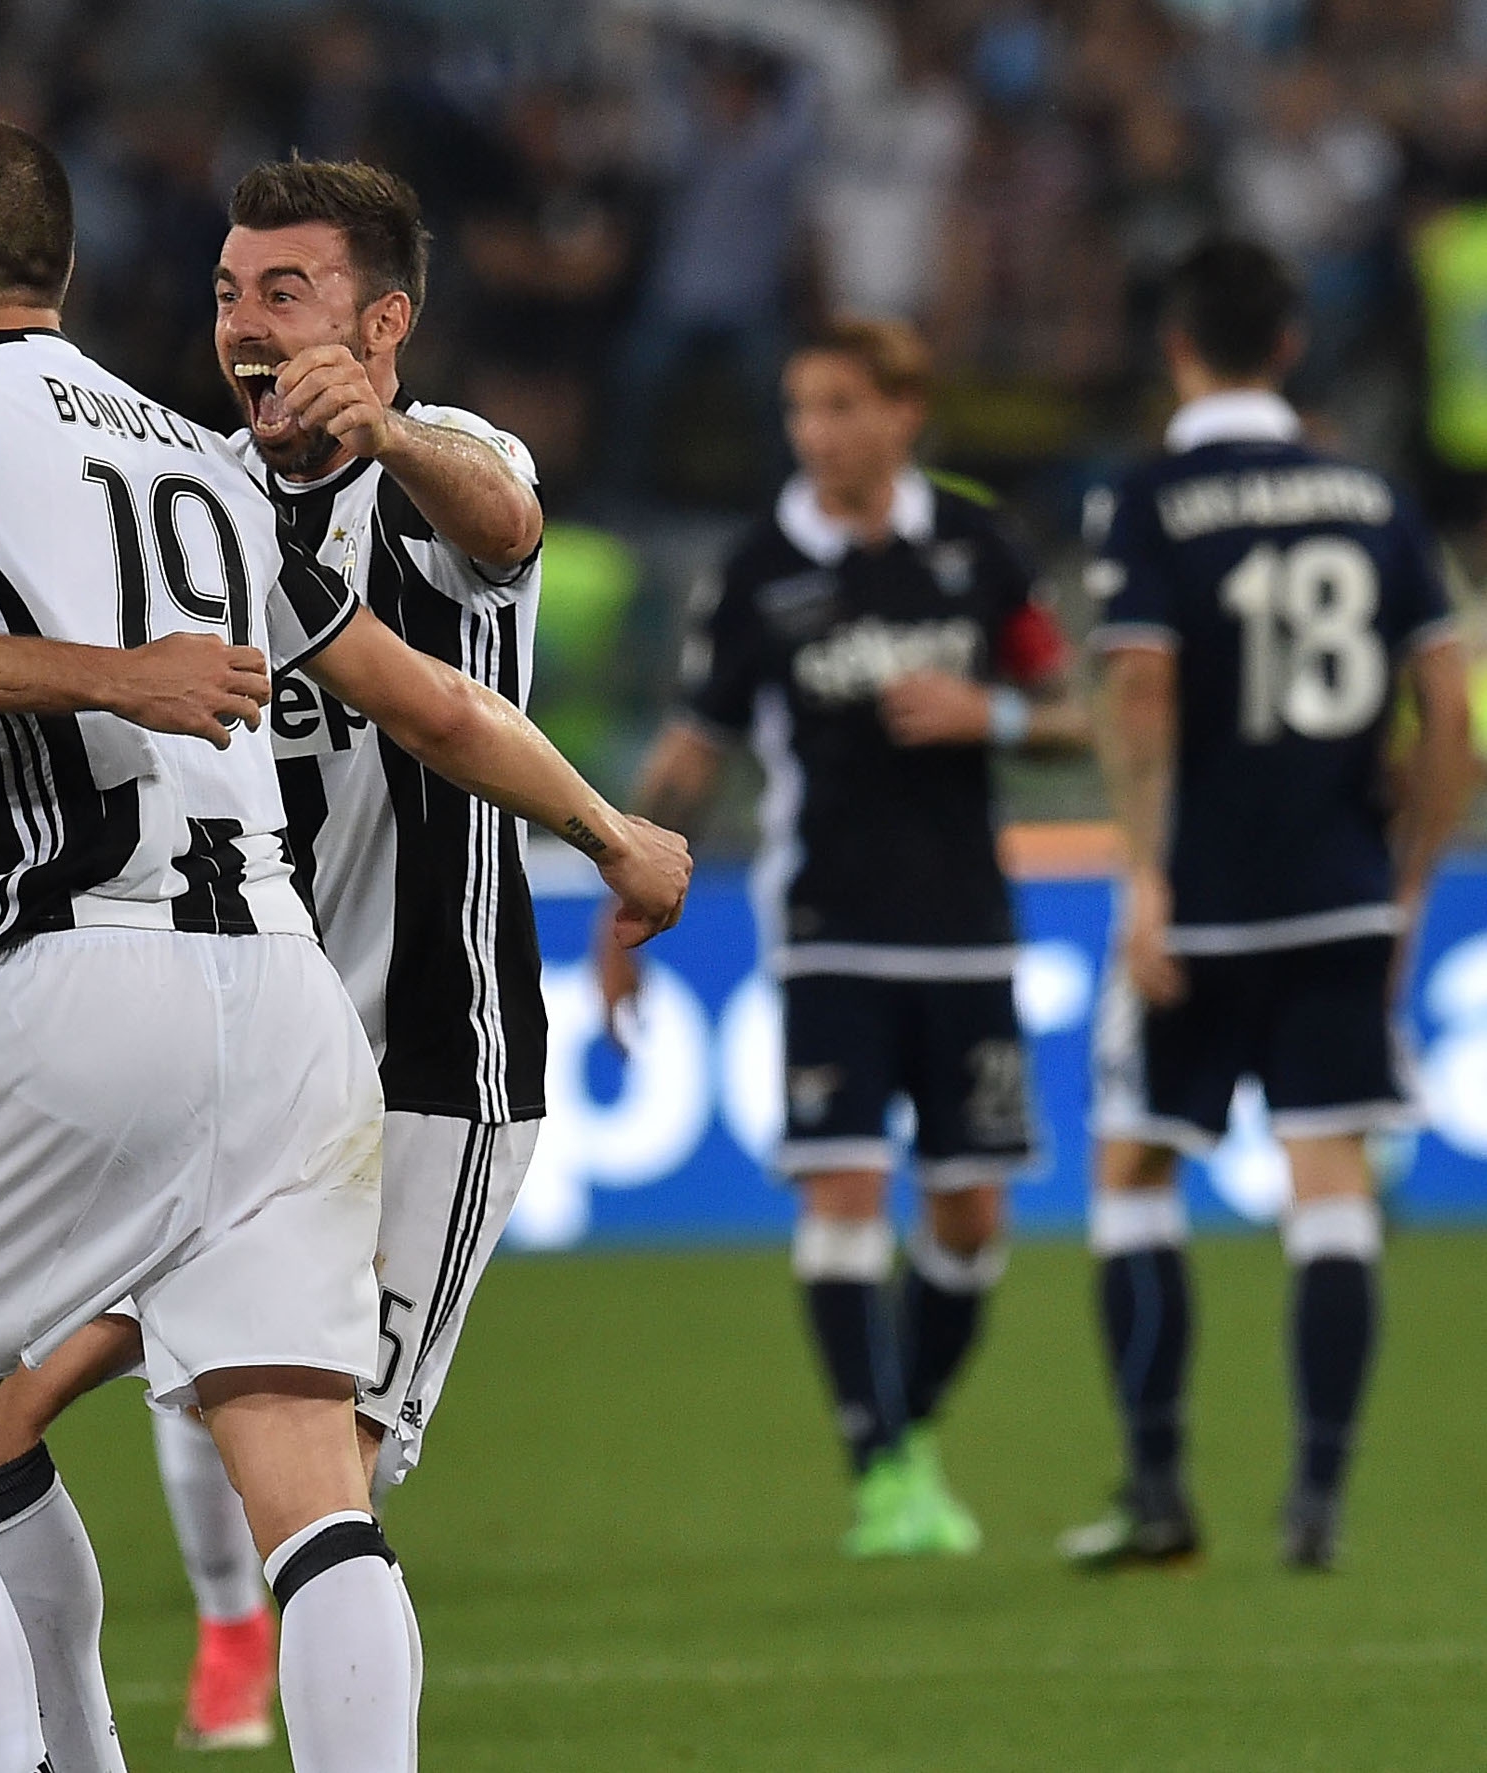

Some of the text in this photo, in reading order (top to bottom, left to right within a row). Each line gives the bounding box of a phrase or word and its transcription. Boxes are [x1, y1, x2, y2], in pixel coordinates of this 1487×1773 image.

[39, 374, 206, 455] BONUCCI
[81, 455, 253, 732] 19
[1217, 534, 1390, 742] 18
[363, 1285, 417, 1400] 5
